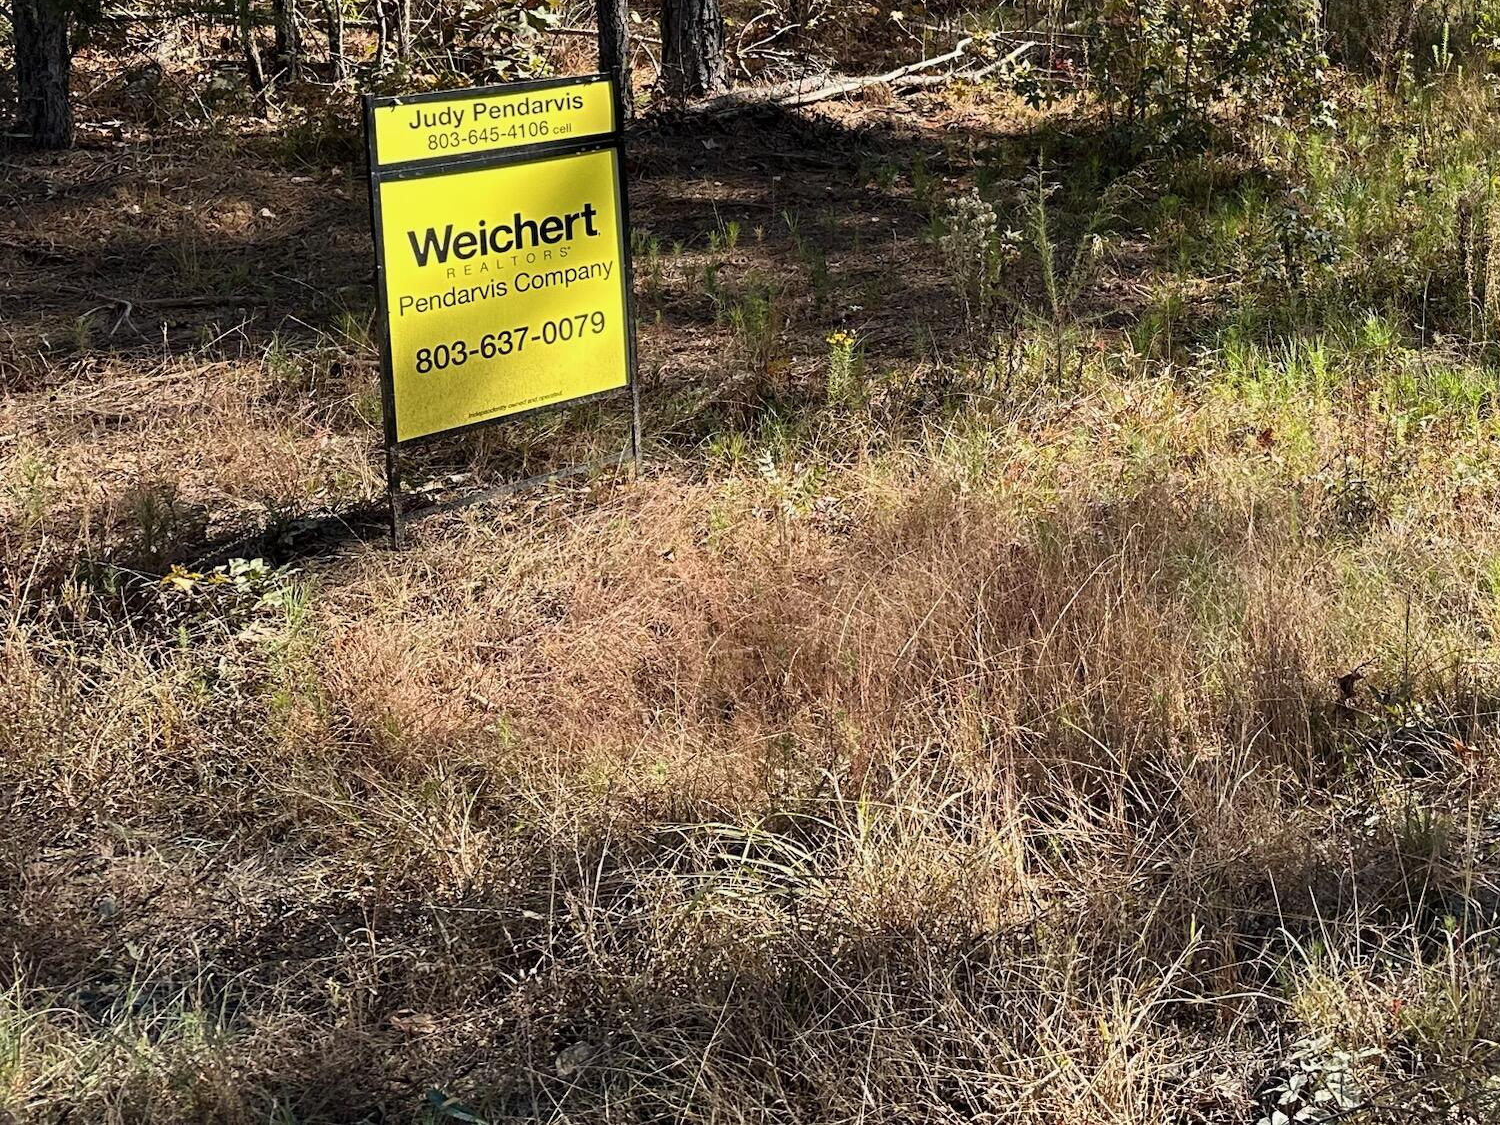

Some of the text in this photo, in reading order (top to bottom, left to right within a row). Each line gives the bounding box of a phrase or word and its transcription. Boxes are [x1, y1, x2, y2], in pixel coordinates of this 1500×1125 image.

[409, 92, 584, 130] Judy Pendarvis
[428, 120, 572, 151] 803-645-4106 cell
[407, 203, 599, 267] Weichert
[399, 260, 614, 316] Pendarvis Company
[415, 311, 605, 374] 803-637-0079
